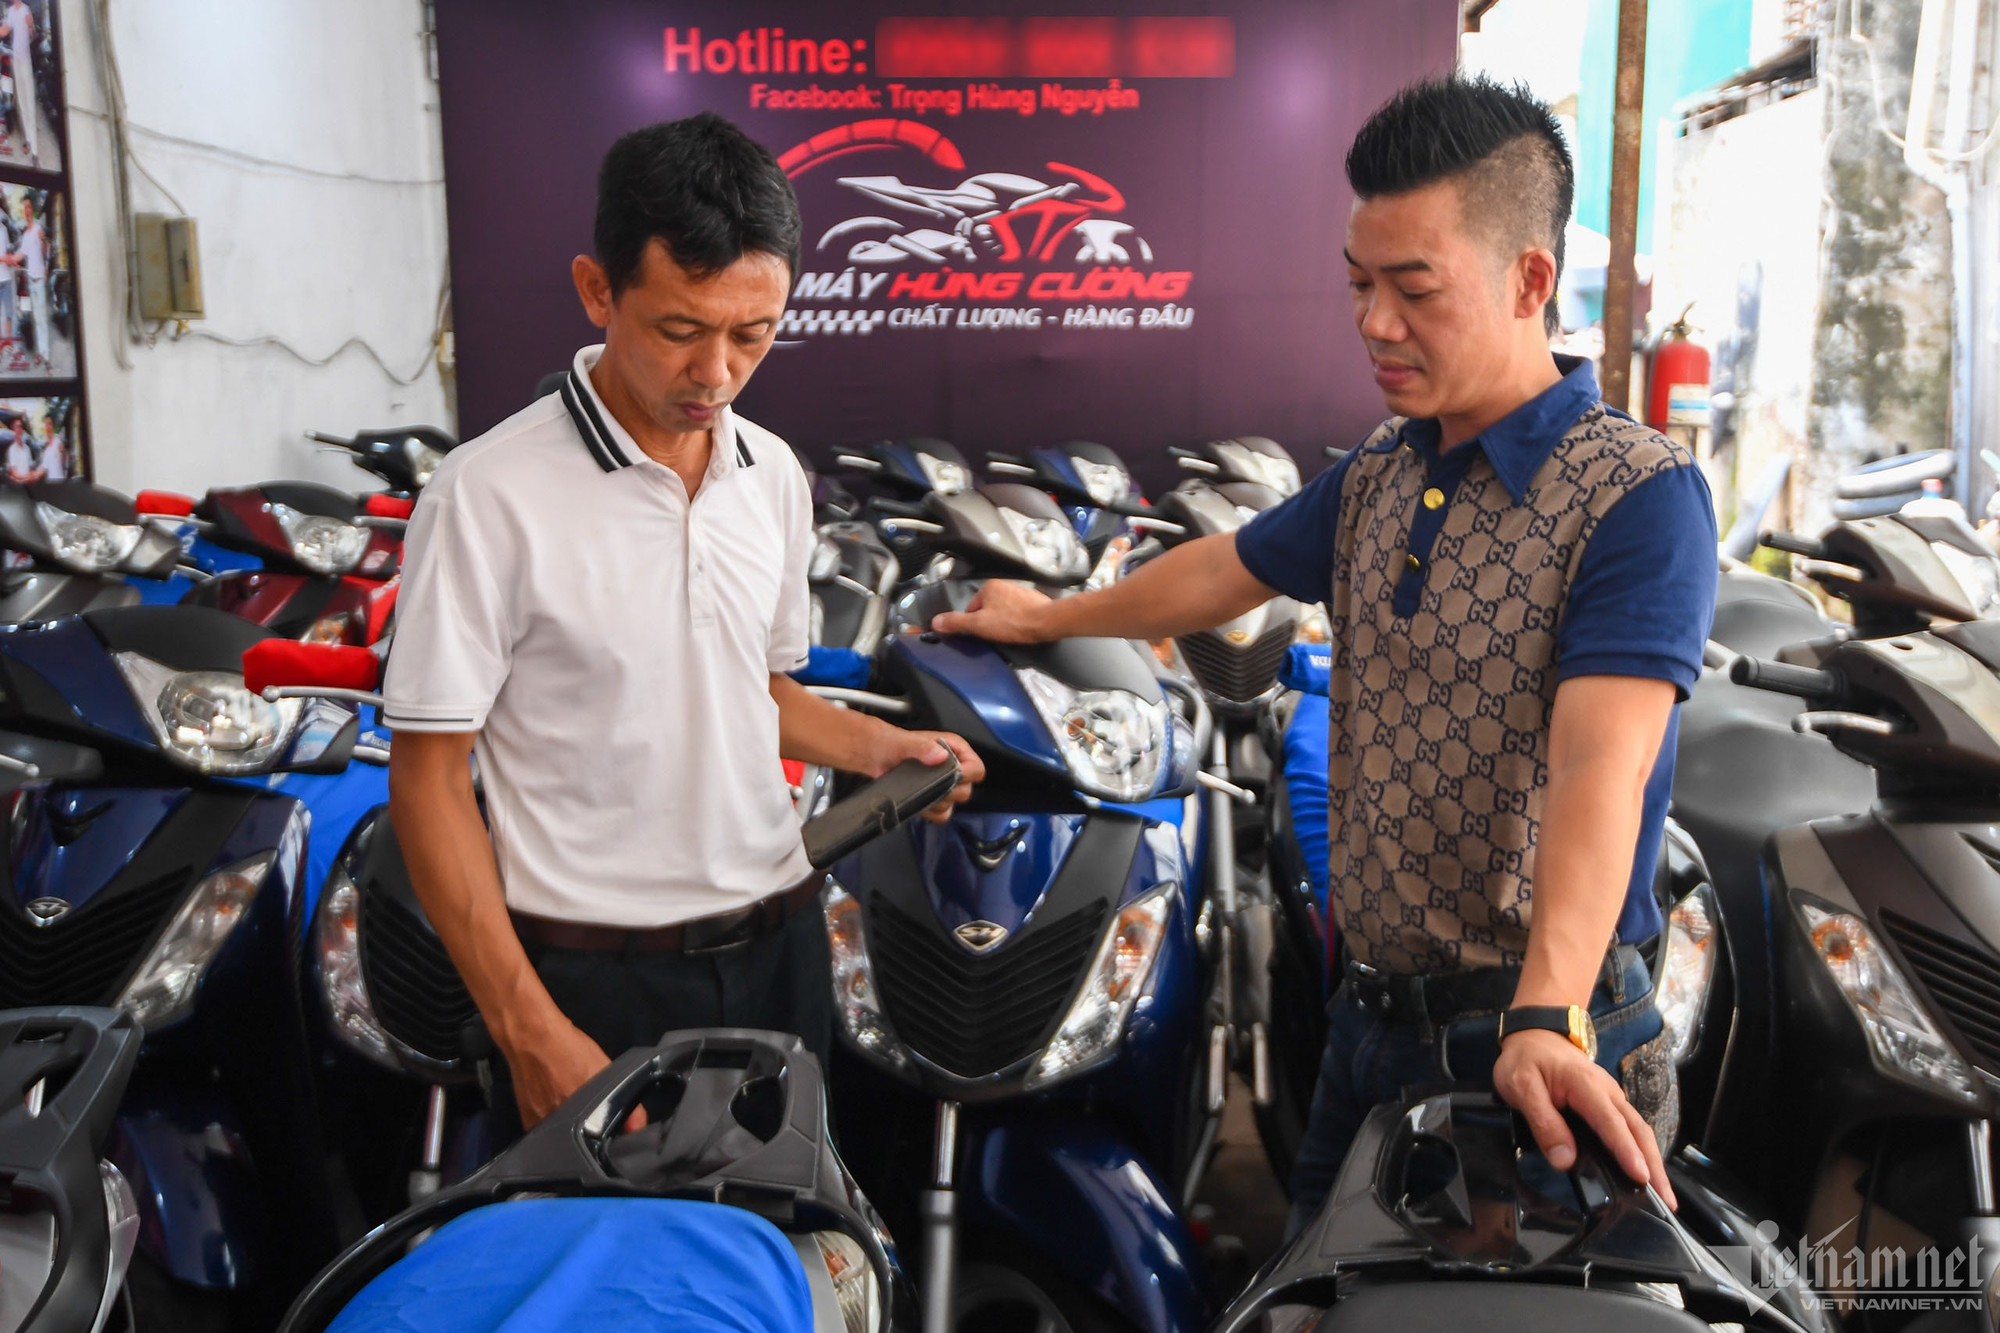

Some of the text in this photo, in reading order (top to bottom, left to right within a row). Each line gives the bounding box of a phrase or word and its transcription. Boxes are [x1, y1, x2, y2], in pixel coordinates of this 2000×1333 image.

[663, 27, 867, 74] Hotline:
[751, 83, 882, 109] Facebook:
[888, 84, 963, 116] Trọng
[1041, 78, 1140, 116] Nguyễn
[792, 266, 889, 299] MÁY
[1027, 266, 1194, 300] CƯỜNG
[887, 303, 954, 329] CHẤT
[956, 307, 1043, 331] LƯỢNG
[1062, 304, 1135, 330] HÀNG
